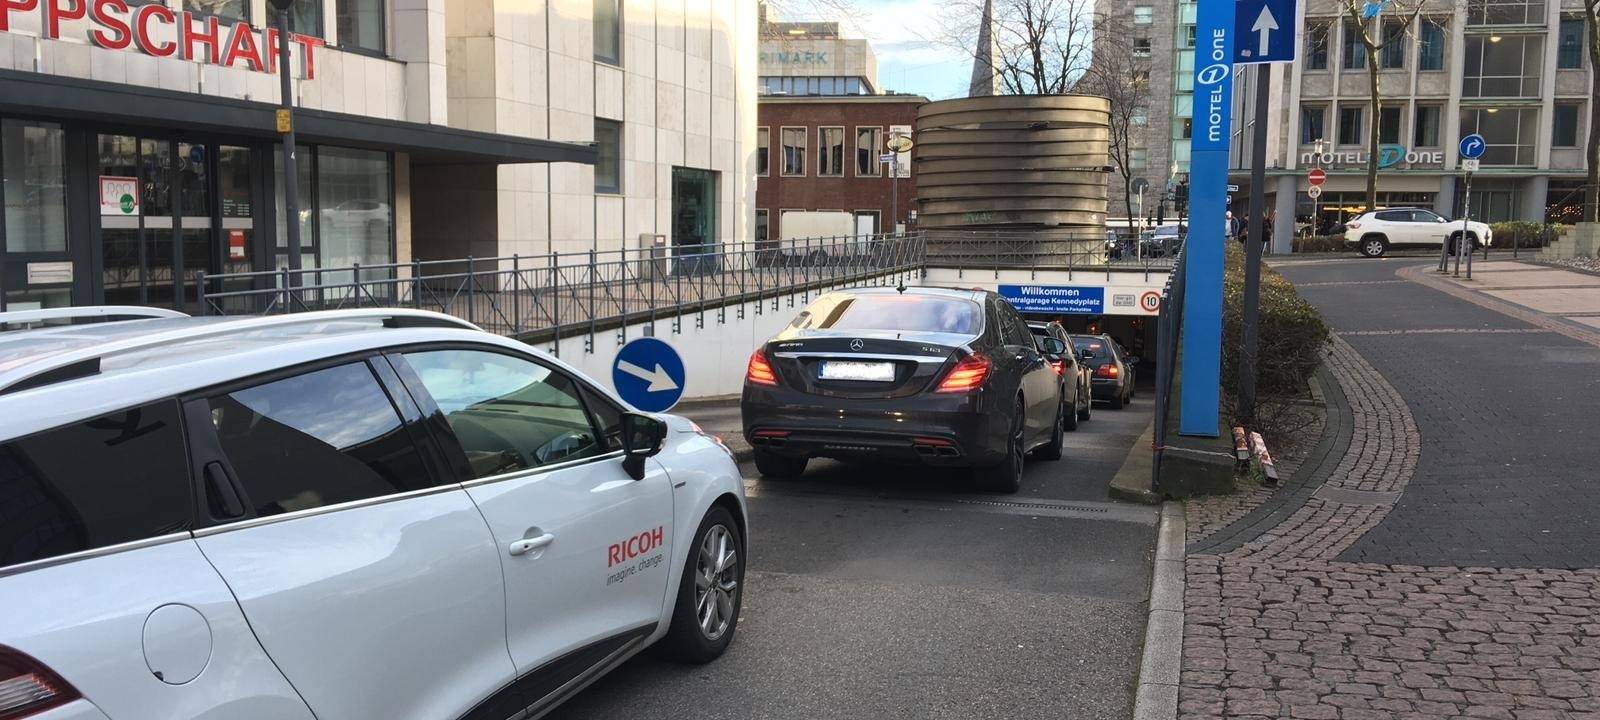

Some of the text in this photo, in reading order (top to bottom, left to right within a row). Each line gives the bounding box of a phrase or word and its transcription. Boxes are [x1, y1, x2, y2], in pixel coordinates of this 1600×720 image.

[1021, 286, 1080, 297] Willkommen
[1004, 297, 1101, 306] entralgarage Kennedyplatz
[1146, 296, 1157, 307] 10
[608, 526, 663, 567] RICOH
